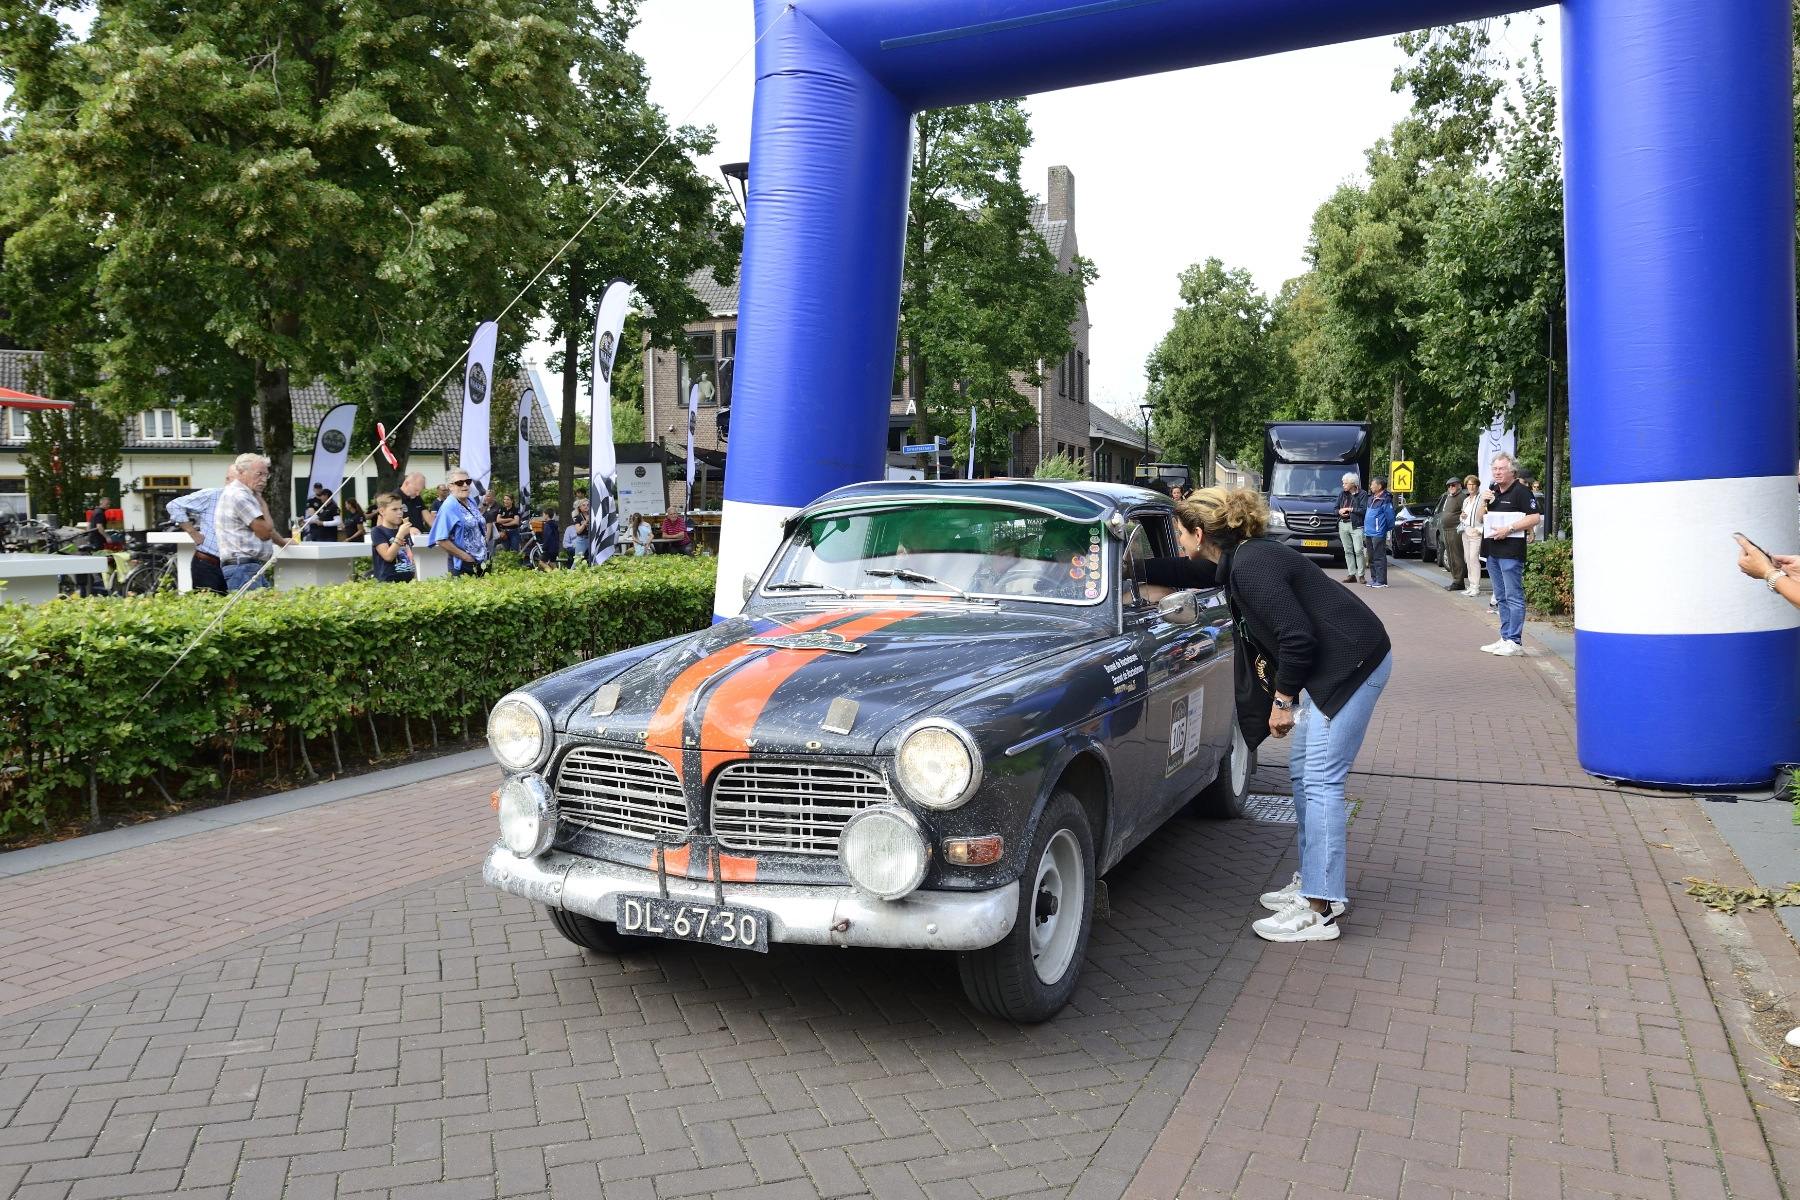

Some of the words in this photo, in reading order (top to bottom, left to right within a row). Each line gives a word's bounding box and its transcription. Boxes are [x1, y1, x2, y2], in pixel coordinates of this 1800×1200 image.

[1398, 475, 1407, 485] K
[598, 726, 822, 750] VOLVO
[625, 900, 757, 945] DL-67-30
